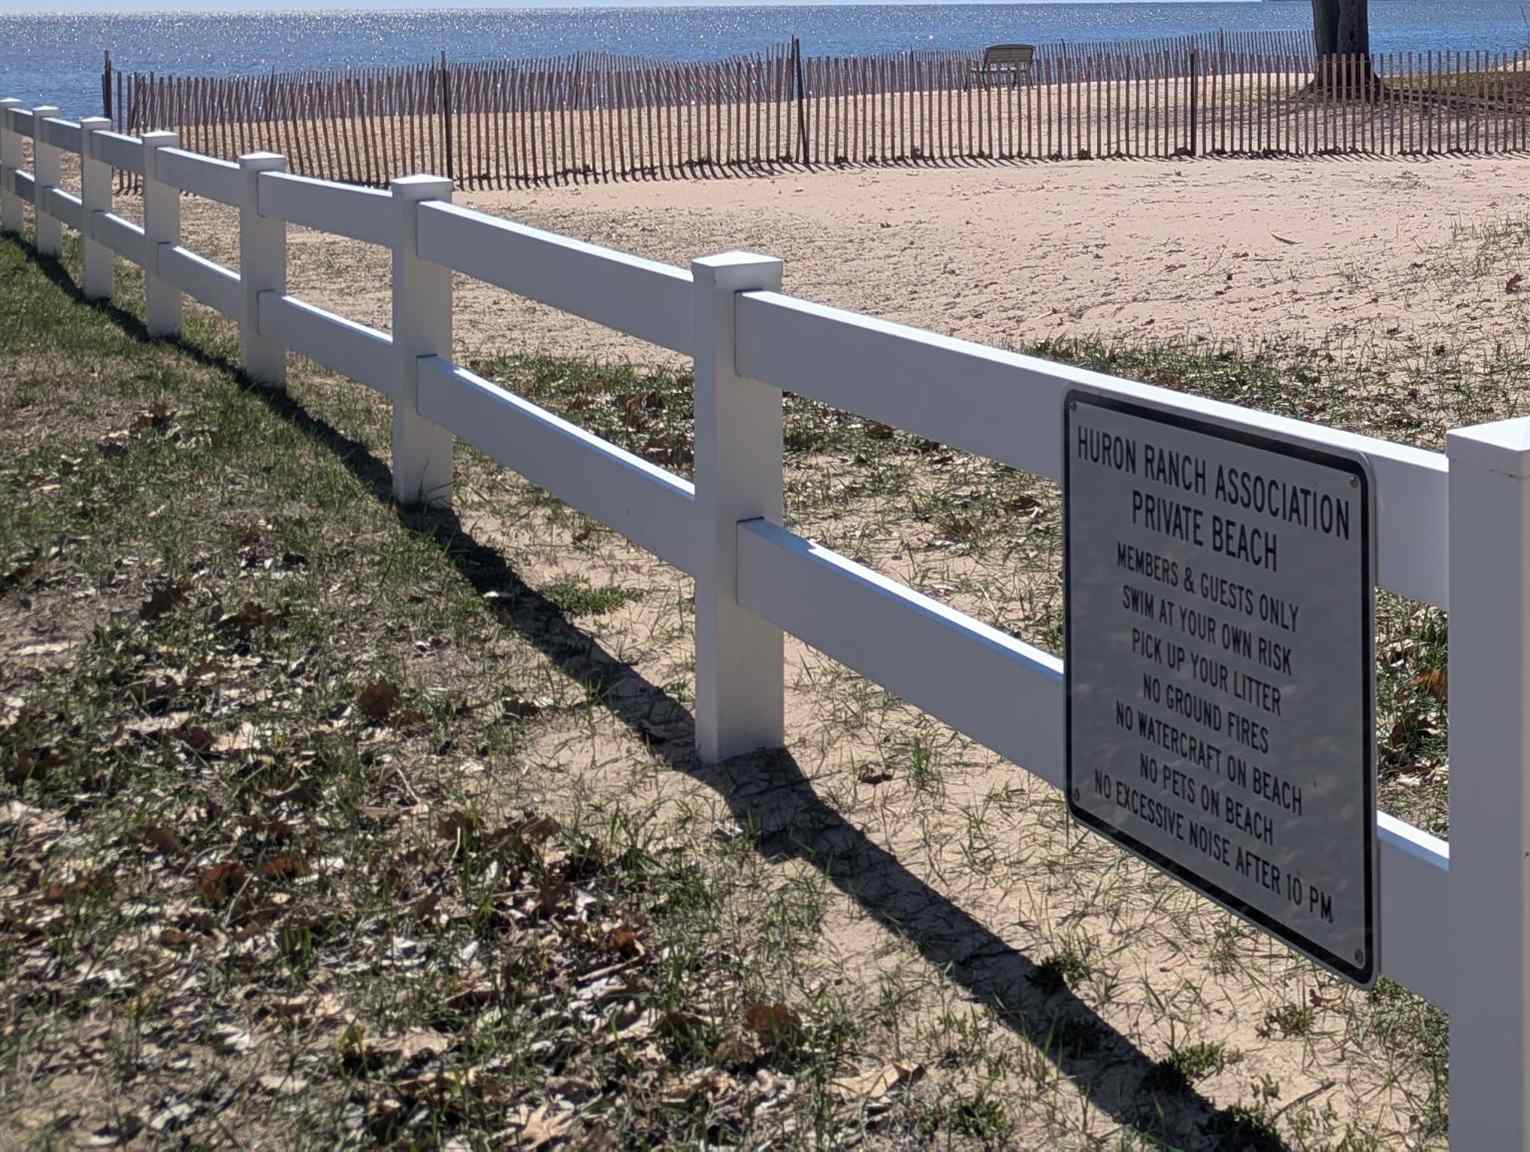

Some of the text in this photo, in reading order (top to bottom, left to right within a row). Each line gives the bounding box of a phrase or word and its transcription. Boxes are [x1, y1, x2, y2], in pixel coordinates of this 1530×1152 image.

[1078, 426, 1350, 540] HURON RANCH ASSOCIATION
[1132, 490, 1277, 572] PRIVATE BEACH
[1117, 541, 1299, 633] MEMBERS & GUESTS ONLY
[1122, 584, 1292, 676] SWIM AT YOUR OWN RISK
[1132, 628, 1281, 717] PICK UP YOUR LITTER
[1143, 672, 1269, 754] NO GROUND FIRES
[1116, 700, 1302, 816] NO WATERCRAFT ON BEACH
[1140, 753, 1273, 846] NO PETS ON BEACH
[1094, 768, 1333, 923] NO EXCESSIVE NOISE AFTER 10 PM
